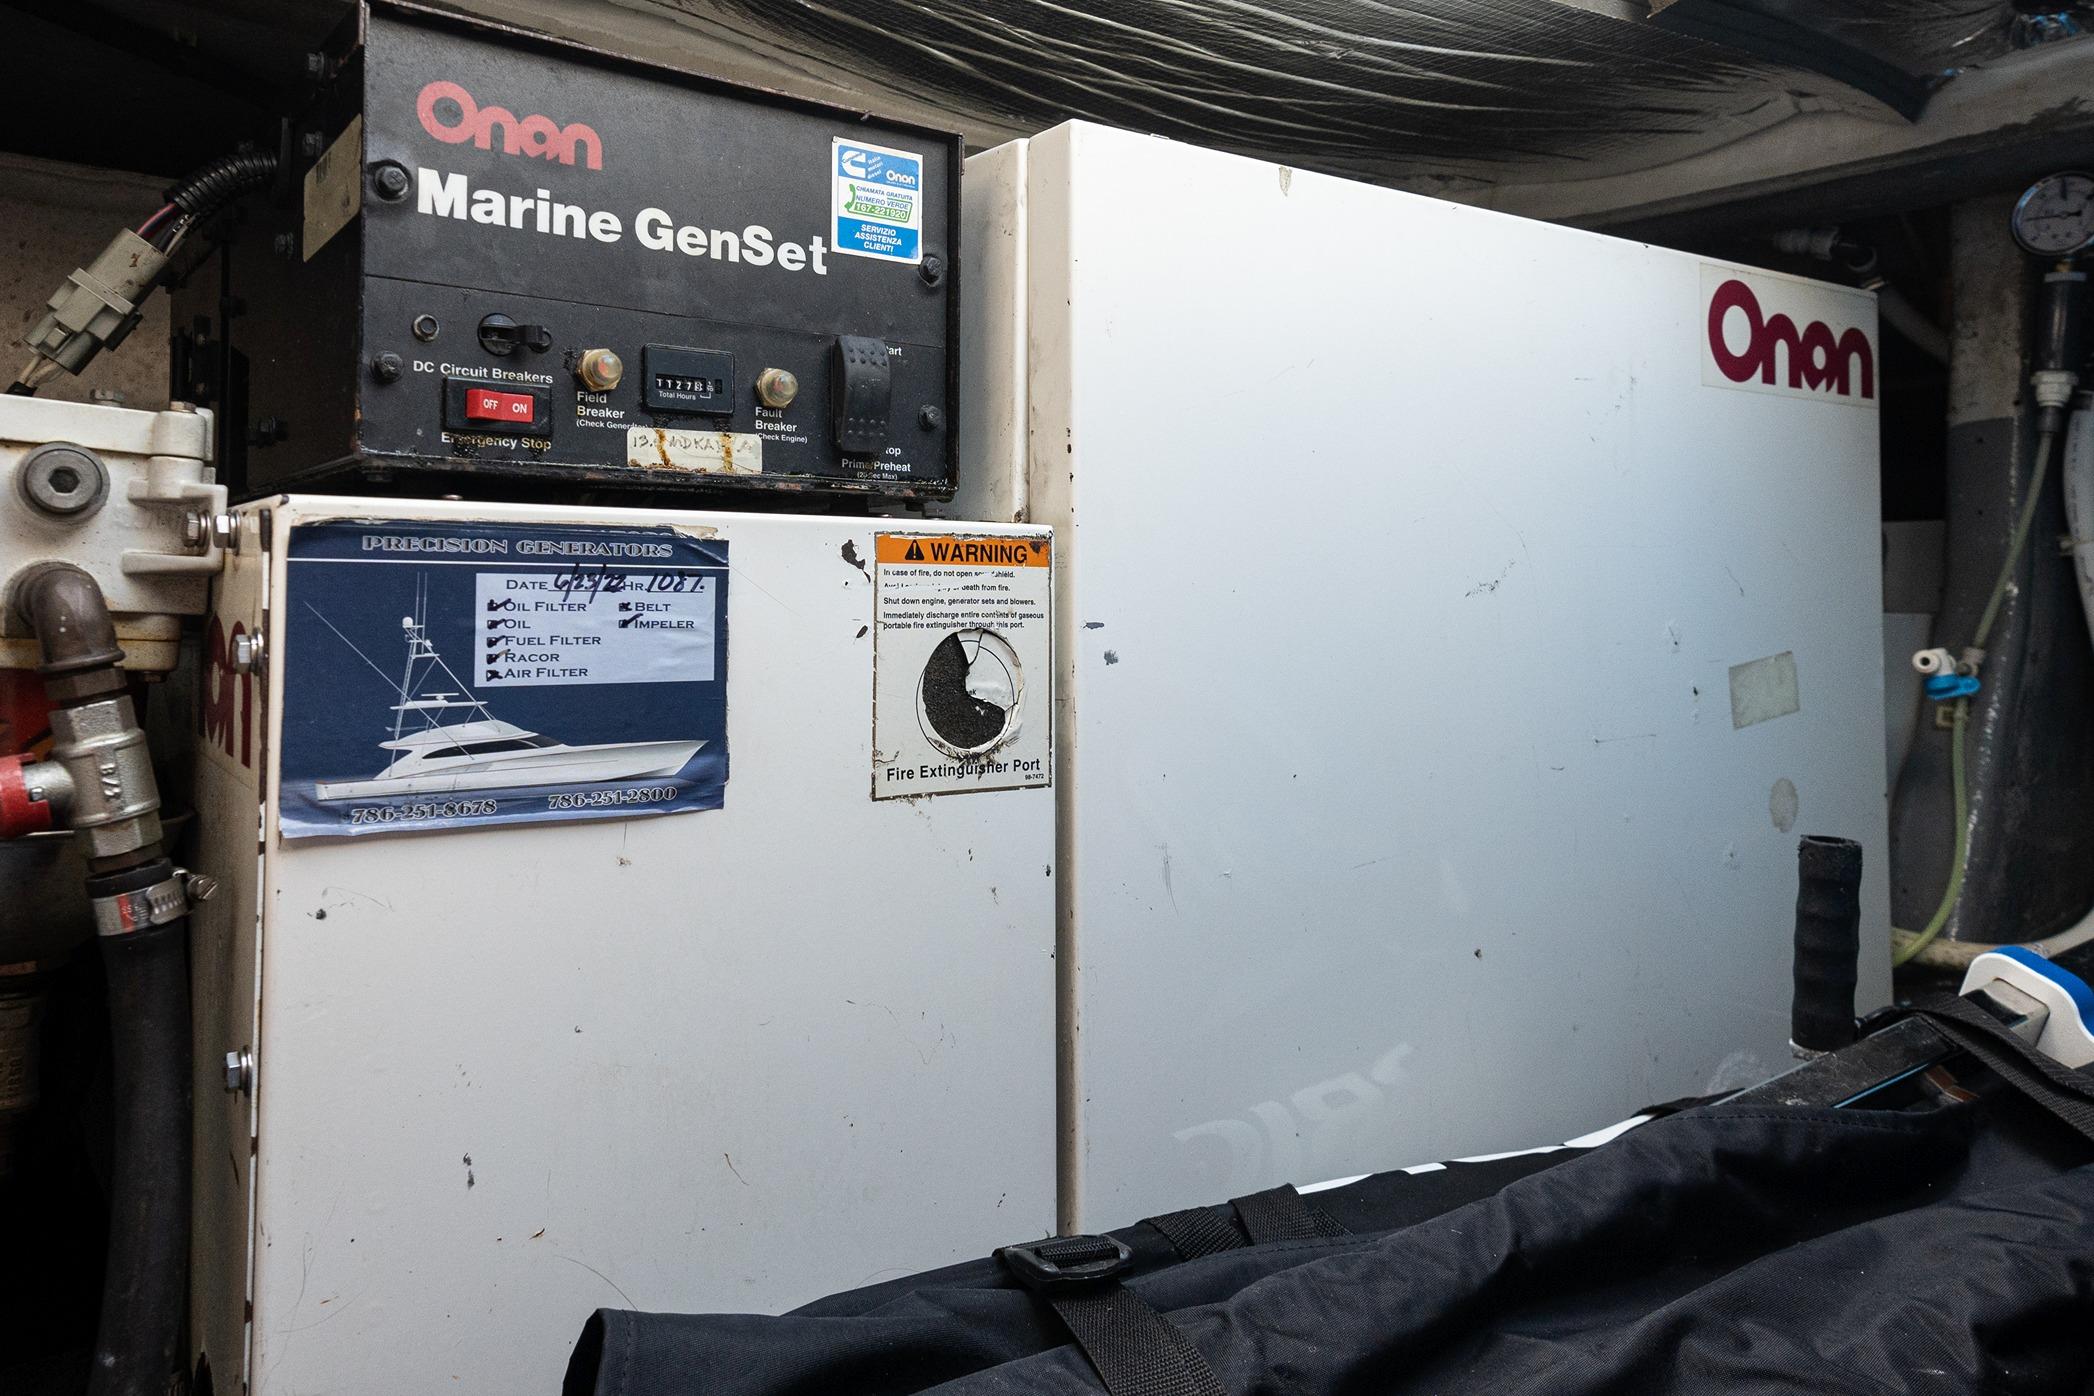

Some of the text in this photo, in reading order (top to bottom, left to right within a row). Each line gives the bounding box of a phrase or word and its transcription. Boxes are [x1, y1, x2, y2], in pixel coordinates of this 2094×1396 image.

[417, 80, 602, 170] Onan
[886, 170, 915, 185] Onan
[856, 186, 912, 201] CHIAMATA GRATUITA
[856, 194, 908, 210] NUMERO VERDE
[856, 203, 906, 219] 167-221920
[417, 166, 828, 275] Marine GenSet
[861, 224, 896, 236] SERVIZIO
[855, 233, 902, 246] ASSISTENZA
[864, 242, 894, 252] CLIENTI
[1708, 280, 1874, 400] Onan
[886, 345, 902, 356] art
[413, 360, 553, 384] DC Circuit Breakers
[577, 392, 607, 403] Field
[483, 399, 527, 414] OFF ON
[577, 406, 625, 419] Breaker
[755, 407, 782, 418] Fault
[576, 419, 604, 428] (Check
[755, 420, 797, 432] Breaker
[522, 438, 551, 452] Stop
[781, 435, 808, 444] Engine)
[362, 536, 674, 557] PRECISION GENERATORS
[931, 542, 1027, 563] WARNING
[918, 569, 931, 577] fire,
[506, 580, 548, 590] DATE
[504, 601, 587, 612] OIL FILTER
[635, 603, 672, 612] BELT
[1010, 598, 1036, 606] blowers.
[926, 612, 959, 620] discharge
[504, 619, 531, 629] OIL
[634, 620, 695, 628] IMPELER
[883, 622, 911, 630] portable
[926, 621, 967, 630] extinguisher
[505, 636, 601, 646] FUEL FILTER
[505, 654, 560, 662] RACOR
[504, 668, 588, 679] AIR FILTER
[886, 758, 1040, 781] Fire Extinguisher Port
[548, 787, 677, 809] 786-251-2800
[351, 800, 497, 824] 786-251-8678
